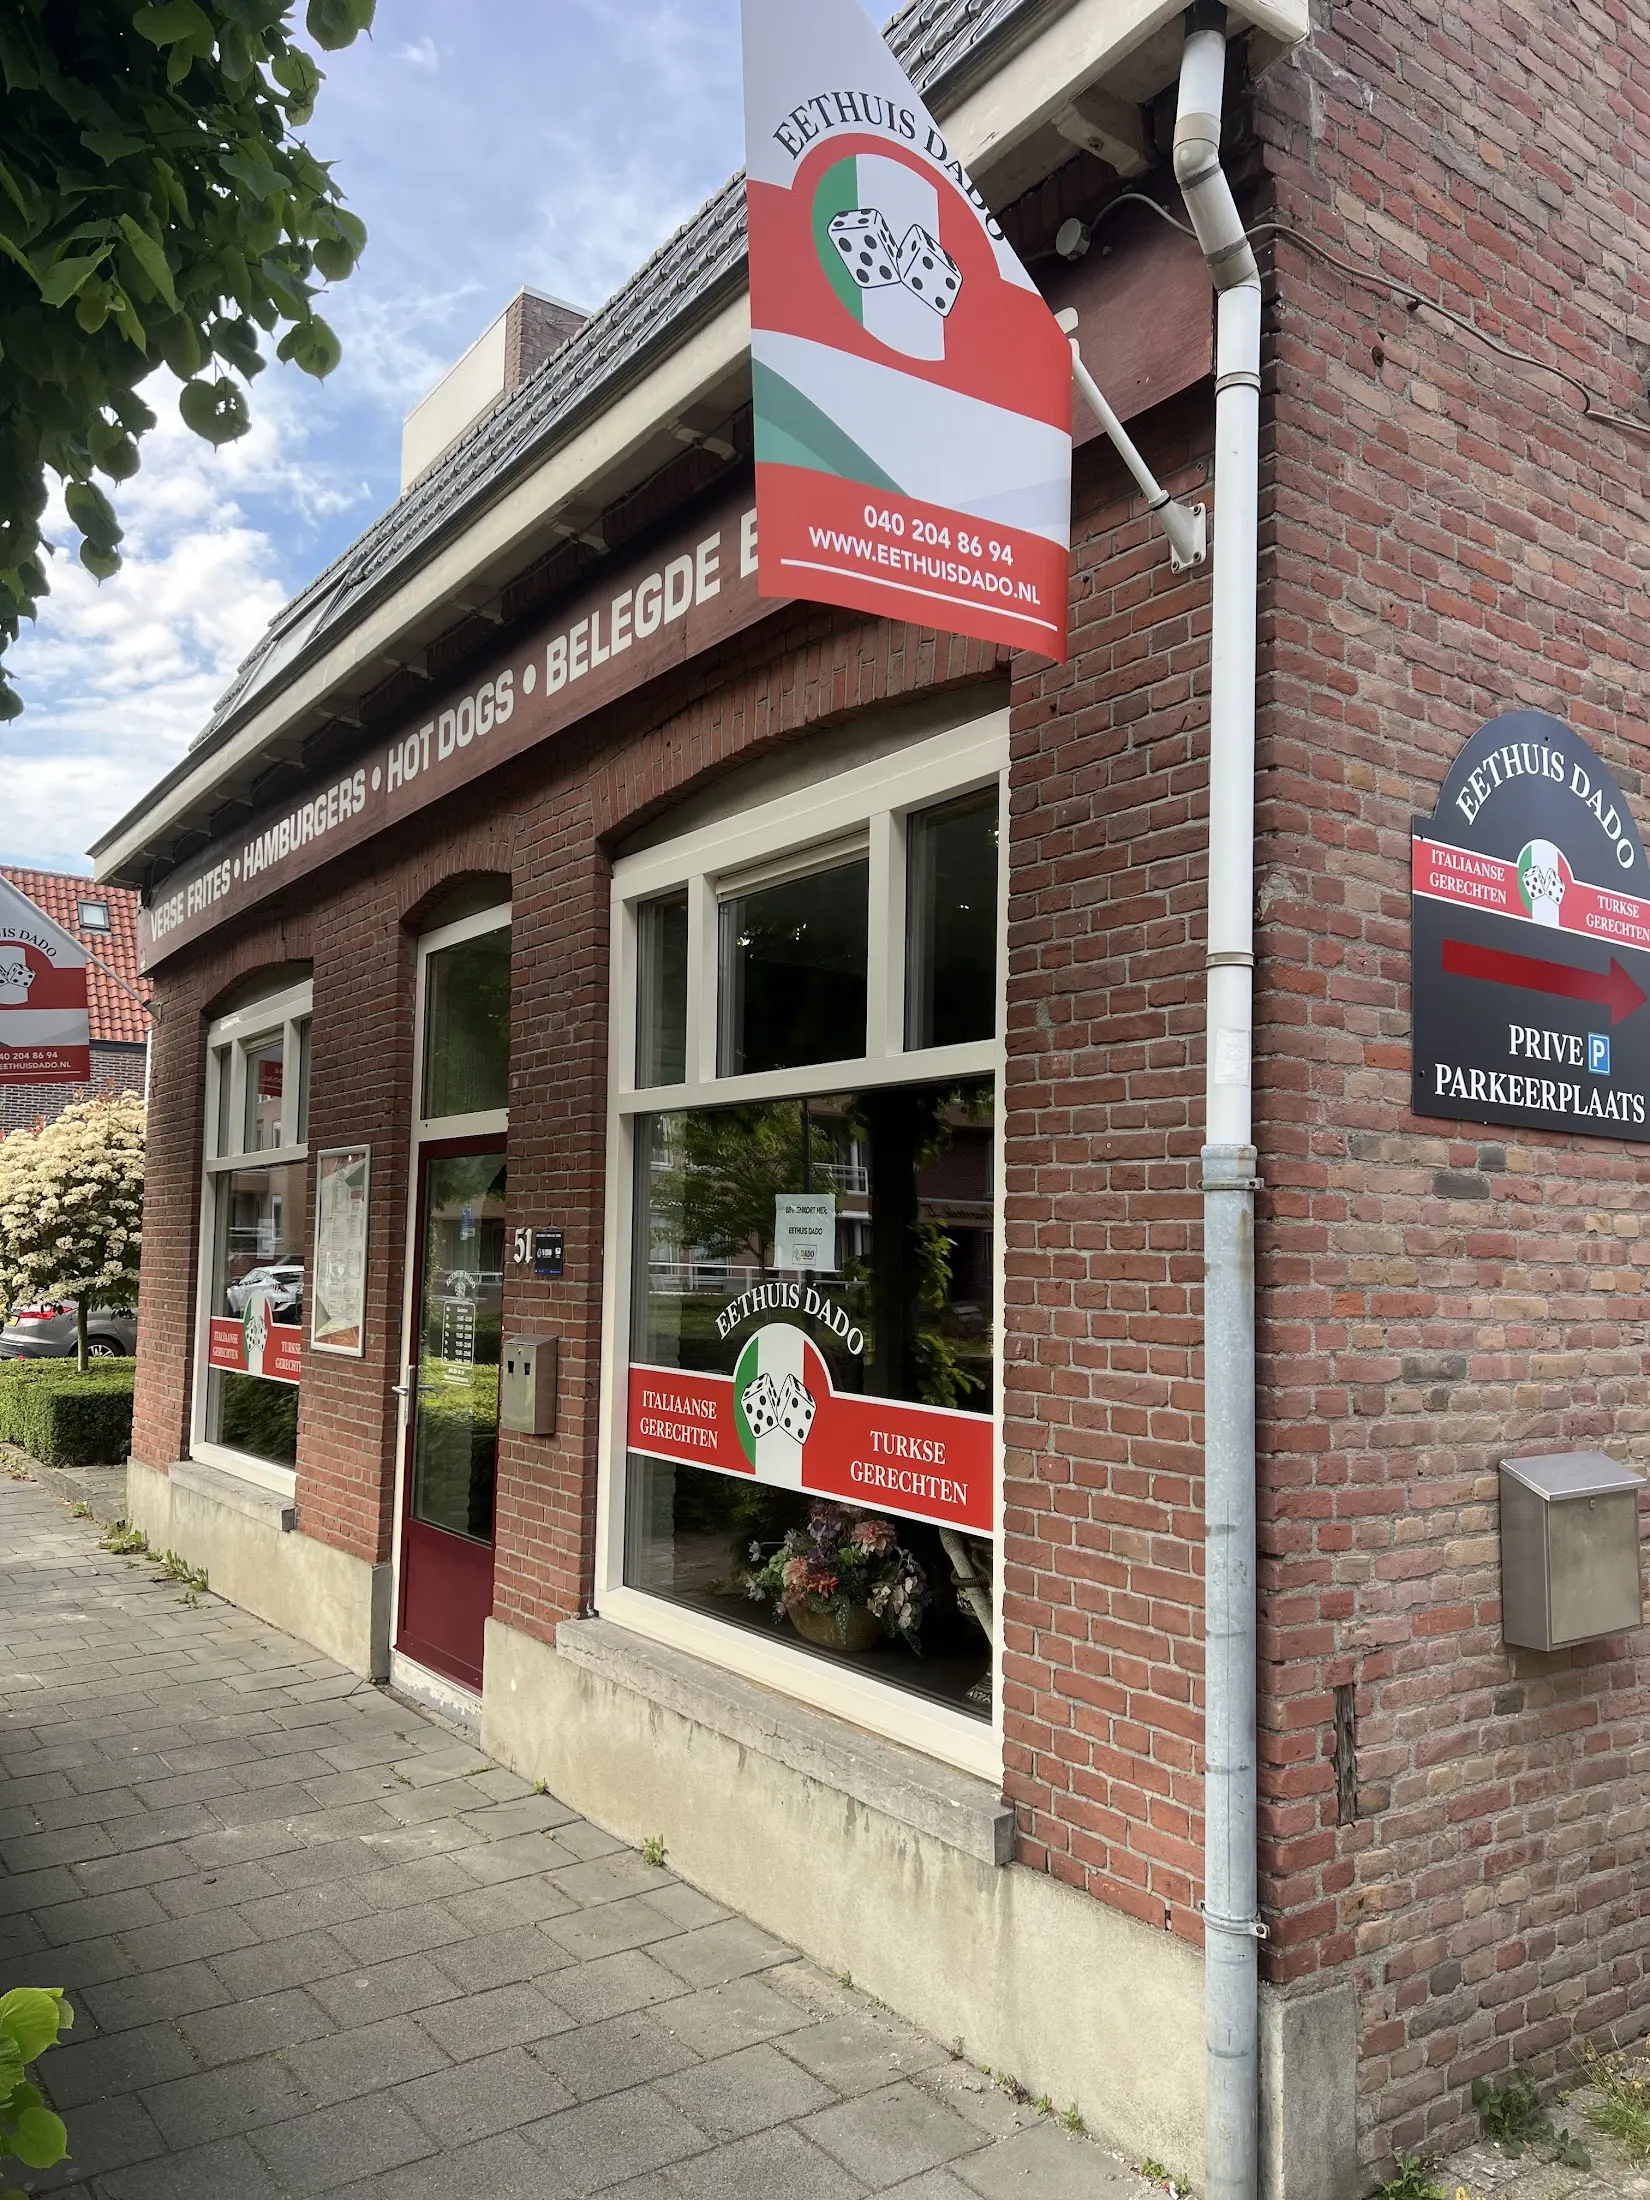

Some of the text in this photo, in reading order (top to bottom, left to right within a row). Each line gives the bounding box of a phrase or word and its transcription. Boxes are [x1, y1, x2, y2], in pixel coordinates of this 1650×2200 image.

[773, 92, 915, 160] EETHUIS
[864, 505, 1013, 566] 040 204 86 94
[809, 526, 1041, 605] WWW.EETHUISDADO.NL
[150, 891, 184, 942] VERSE
[187, 859, 230, 918] FRITES
[243, 768, 365, 882] HAMBURGERS
[387, 722, 433, 793] HOT
[438, 668, 514, 762] DOGS
[546, 531, 720, 697] BELEGDE
[1456, 743, 1635, 868] EETHUIS DADO
[1431, 849, 1505, 882] ITALIAANSE
[1430, 872, 1507, 904] GERECHTEN
[1597, 895, 1639, 918] TURKSE
[19, 930, 57, 957] DADO
[1586, 913, 1650, 942] GERECHTEN
[13, 1052, 30, 1060] 204
[32, 1051, 44, 1059] 86
[46, 1051, 58, 1059] 94
[1509, 1024, 1584, 1066] PRIVE
[1435, 1063, 1645, 1124] PARKEERPLAATS
[514, 1227, 533, 1263] 51
[788, 1226, 823, 1236] EETHUIS DADO
[715, 1282, 864, 1355] EETHUIS DADO
[643, 1390, 717, 1420] ITALIAANSE
[640, 1417, 718, 1449] GERECHTEN
[870, 1430, 946, 1465] TURKSE
[850, 1460, 968, 1505] GERECHTEN
